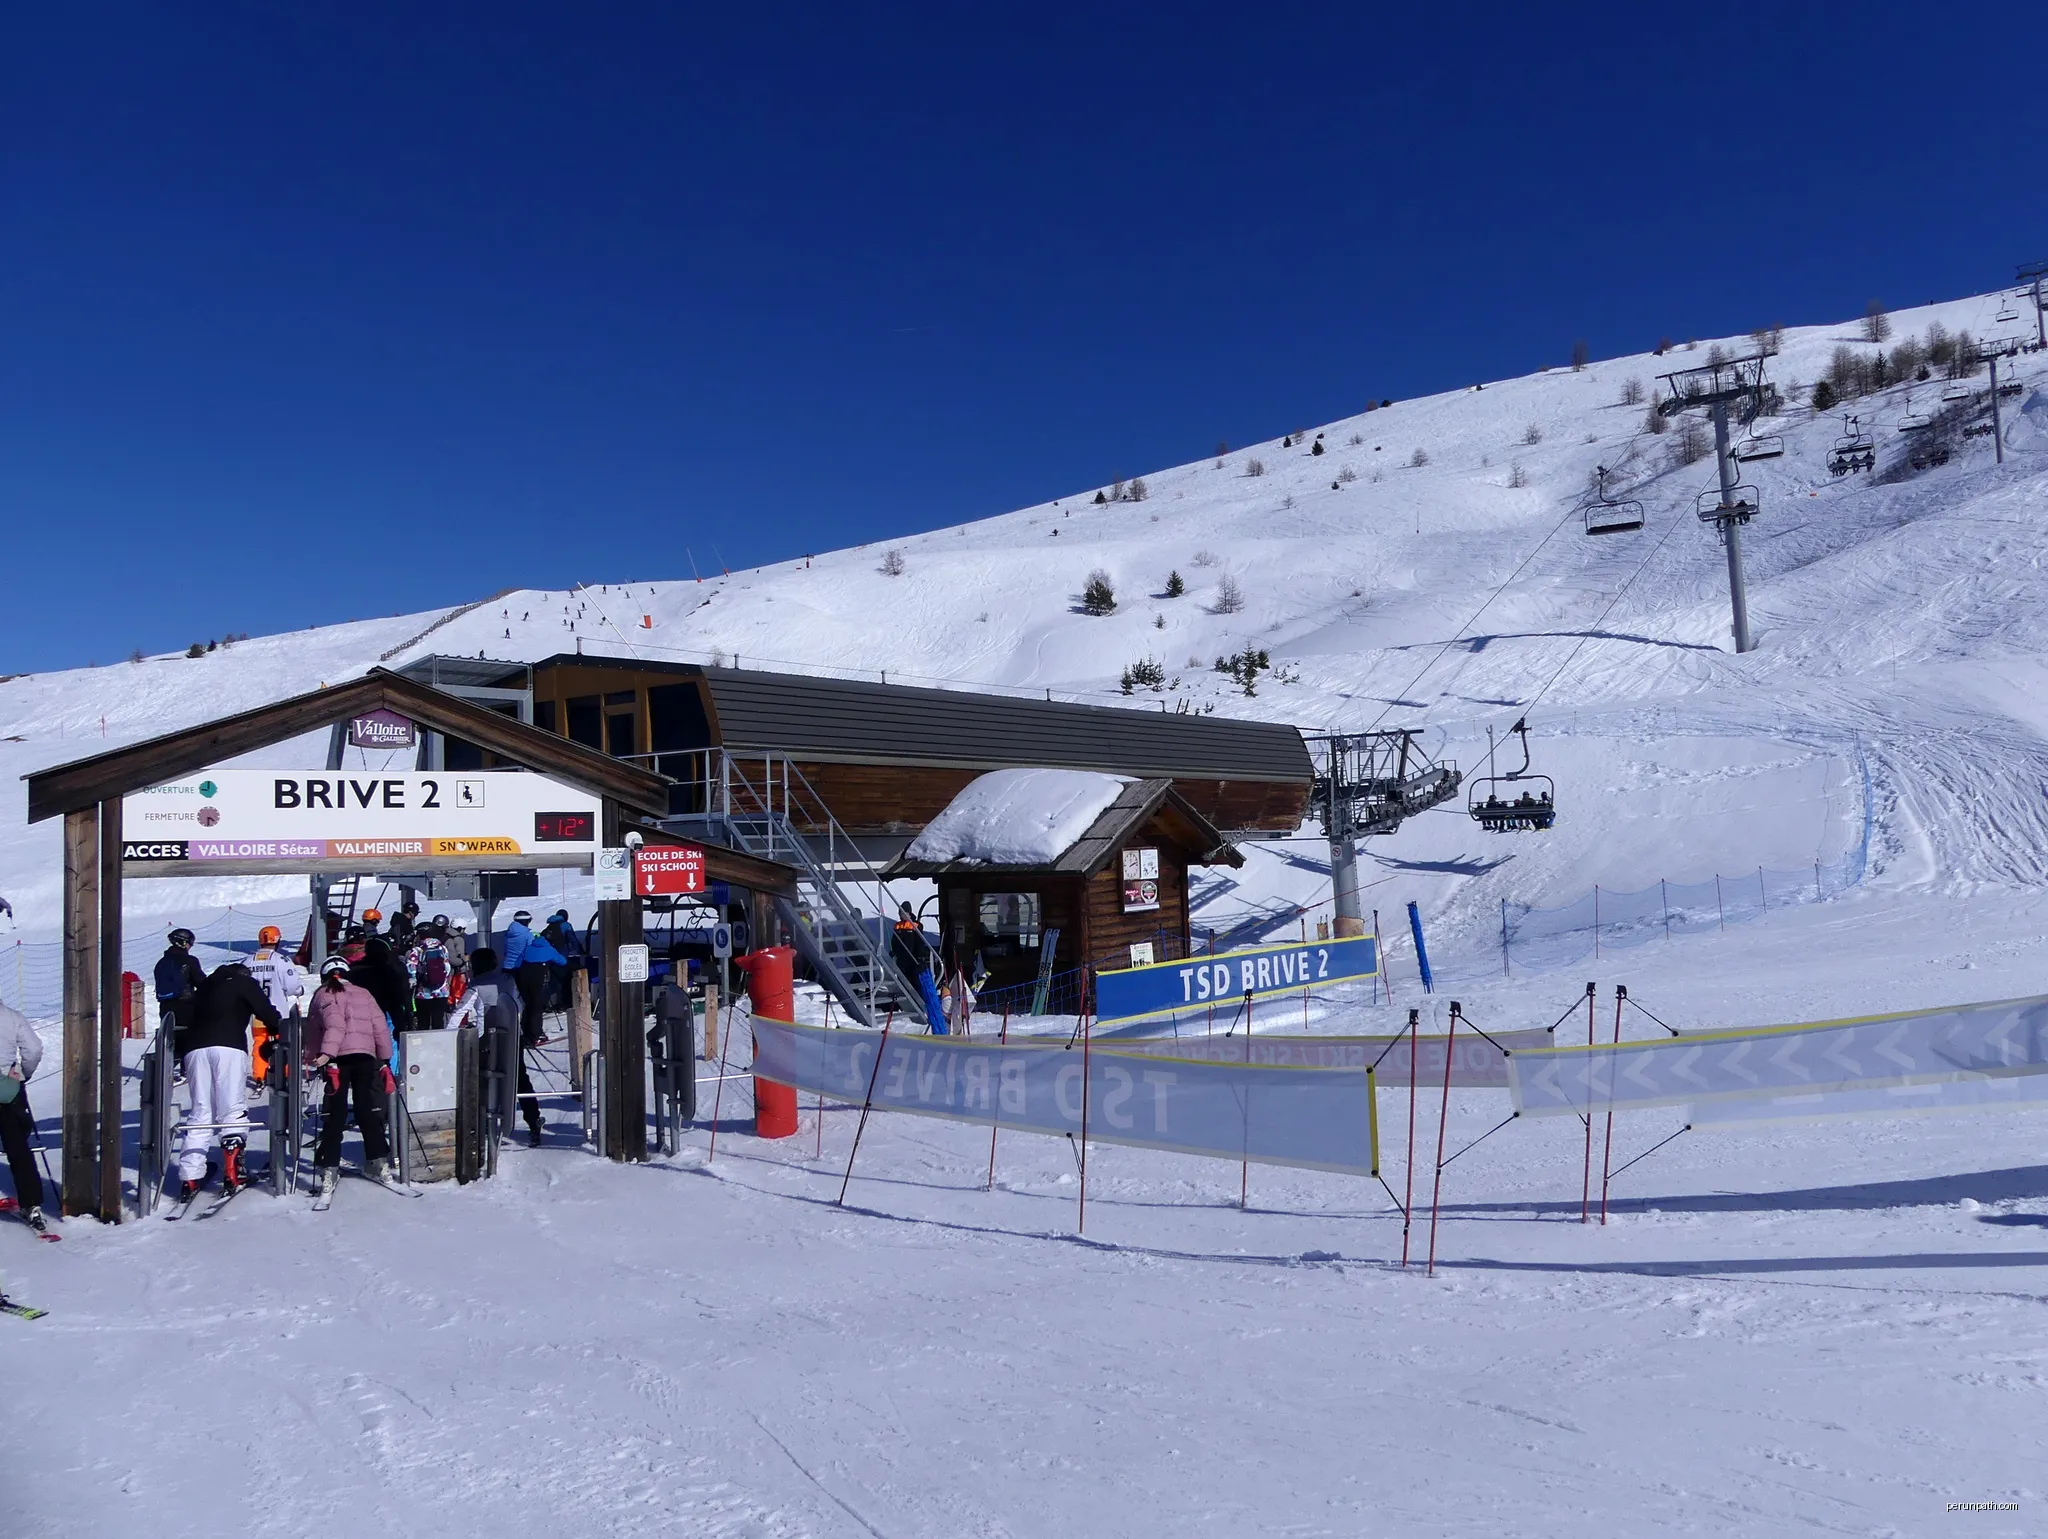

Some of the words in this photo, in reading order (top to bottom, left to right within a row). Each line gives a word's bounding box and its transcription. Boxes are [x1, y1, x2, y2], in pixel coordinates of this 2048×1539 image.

[354, 719, 406, 739] Valloire
[143, 786, 195, 794] OUVERTURE
[274, 779, 405, 809] BRIVE
[420, 779, 441, 809] 2
[144, 812, 195, 821] FERMETURE
[198, 843, 276, 857] VALLOIRE
[279, 842, 319, 856] Sétaz
[335, 841, 423, 855] VALMEINIER
[439, 840, 512, 852] SNOWPARK
[637, 851, 669, 861] ECOLE
[671, 851, 684, 860] DE
[686, 850, 702, 859] SKI
[641, 863, 658, 872] SKI
[660, 861, 700, 872] SCHOOL
[1179, 963, 1231, 1002] TSD
[1241, 950, 1310, 992] BRIVE
[1318, 948, 1329, 978] 2
